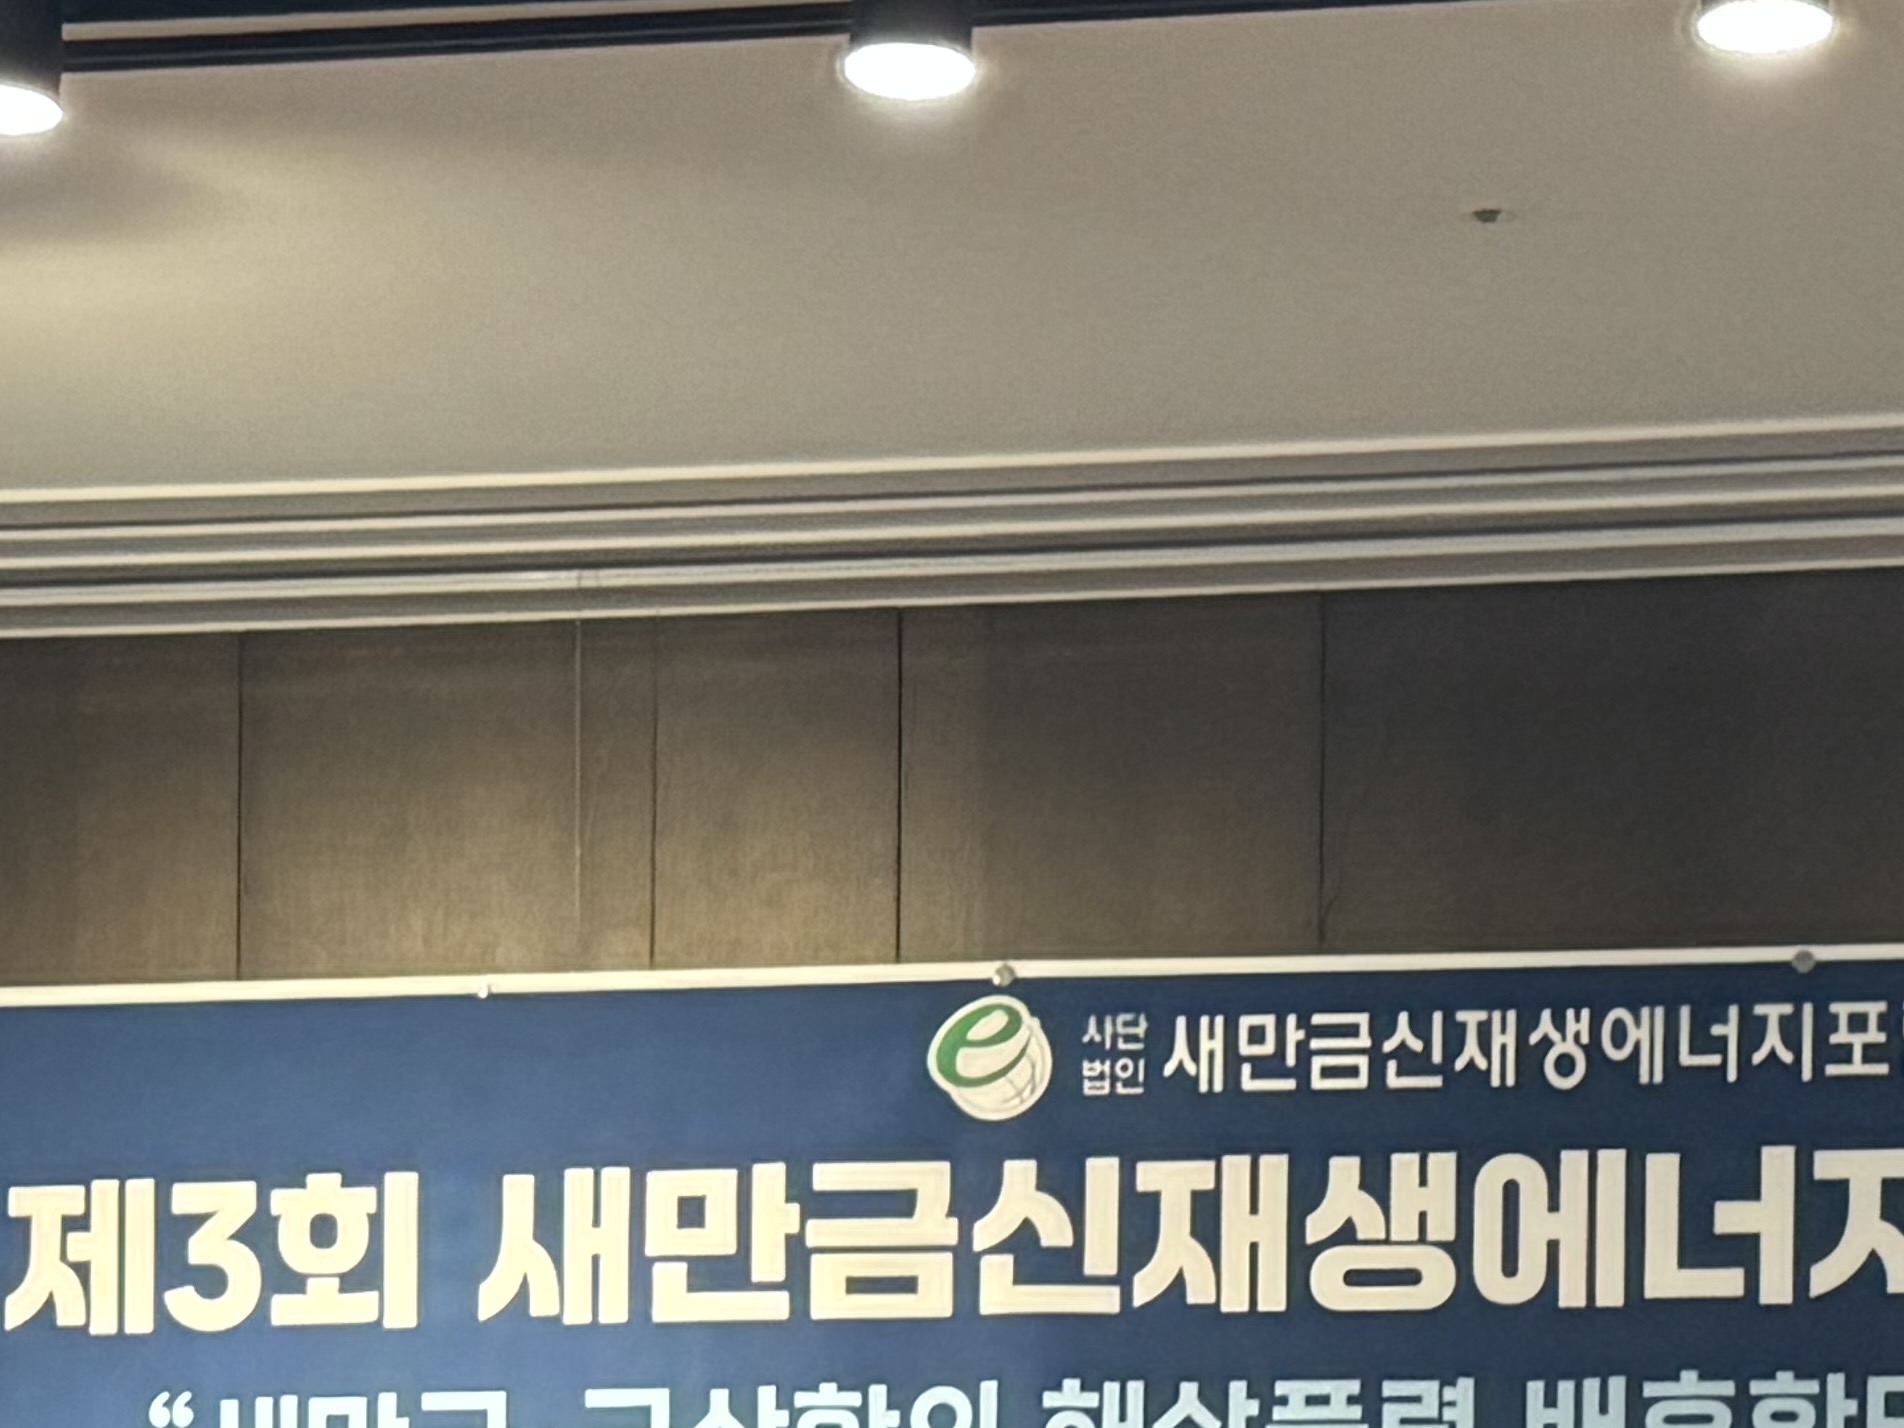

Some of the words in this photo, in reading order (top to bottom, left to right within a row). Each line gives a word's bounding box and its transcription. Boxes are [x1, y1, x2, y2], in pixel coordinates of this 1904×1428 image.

[1082, 1014, 1147, 1050] 사단
[1083, 1058, 1144, 1095] 법인
[5, 1172, 418, 1335] 제3회
